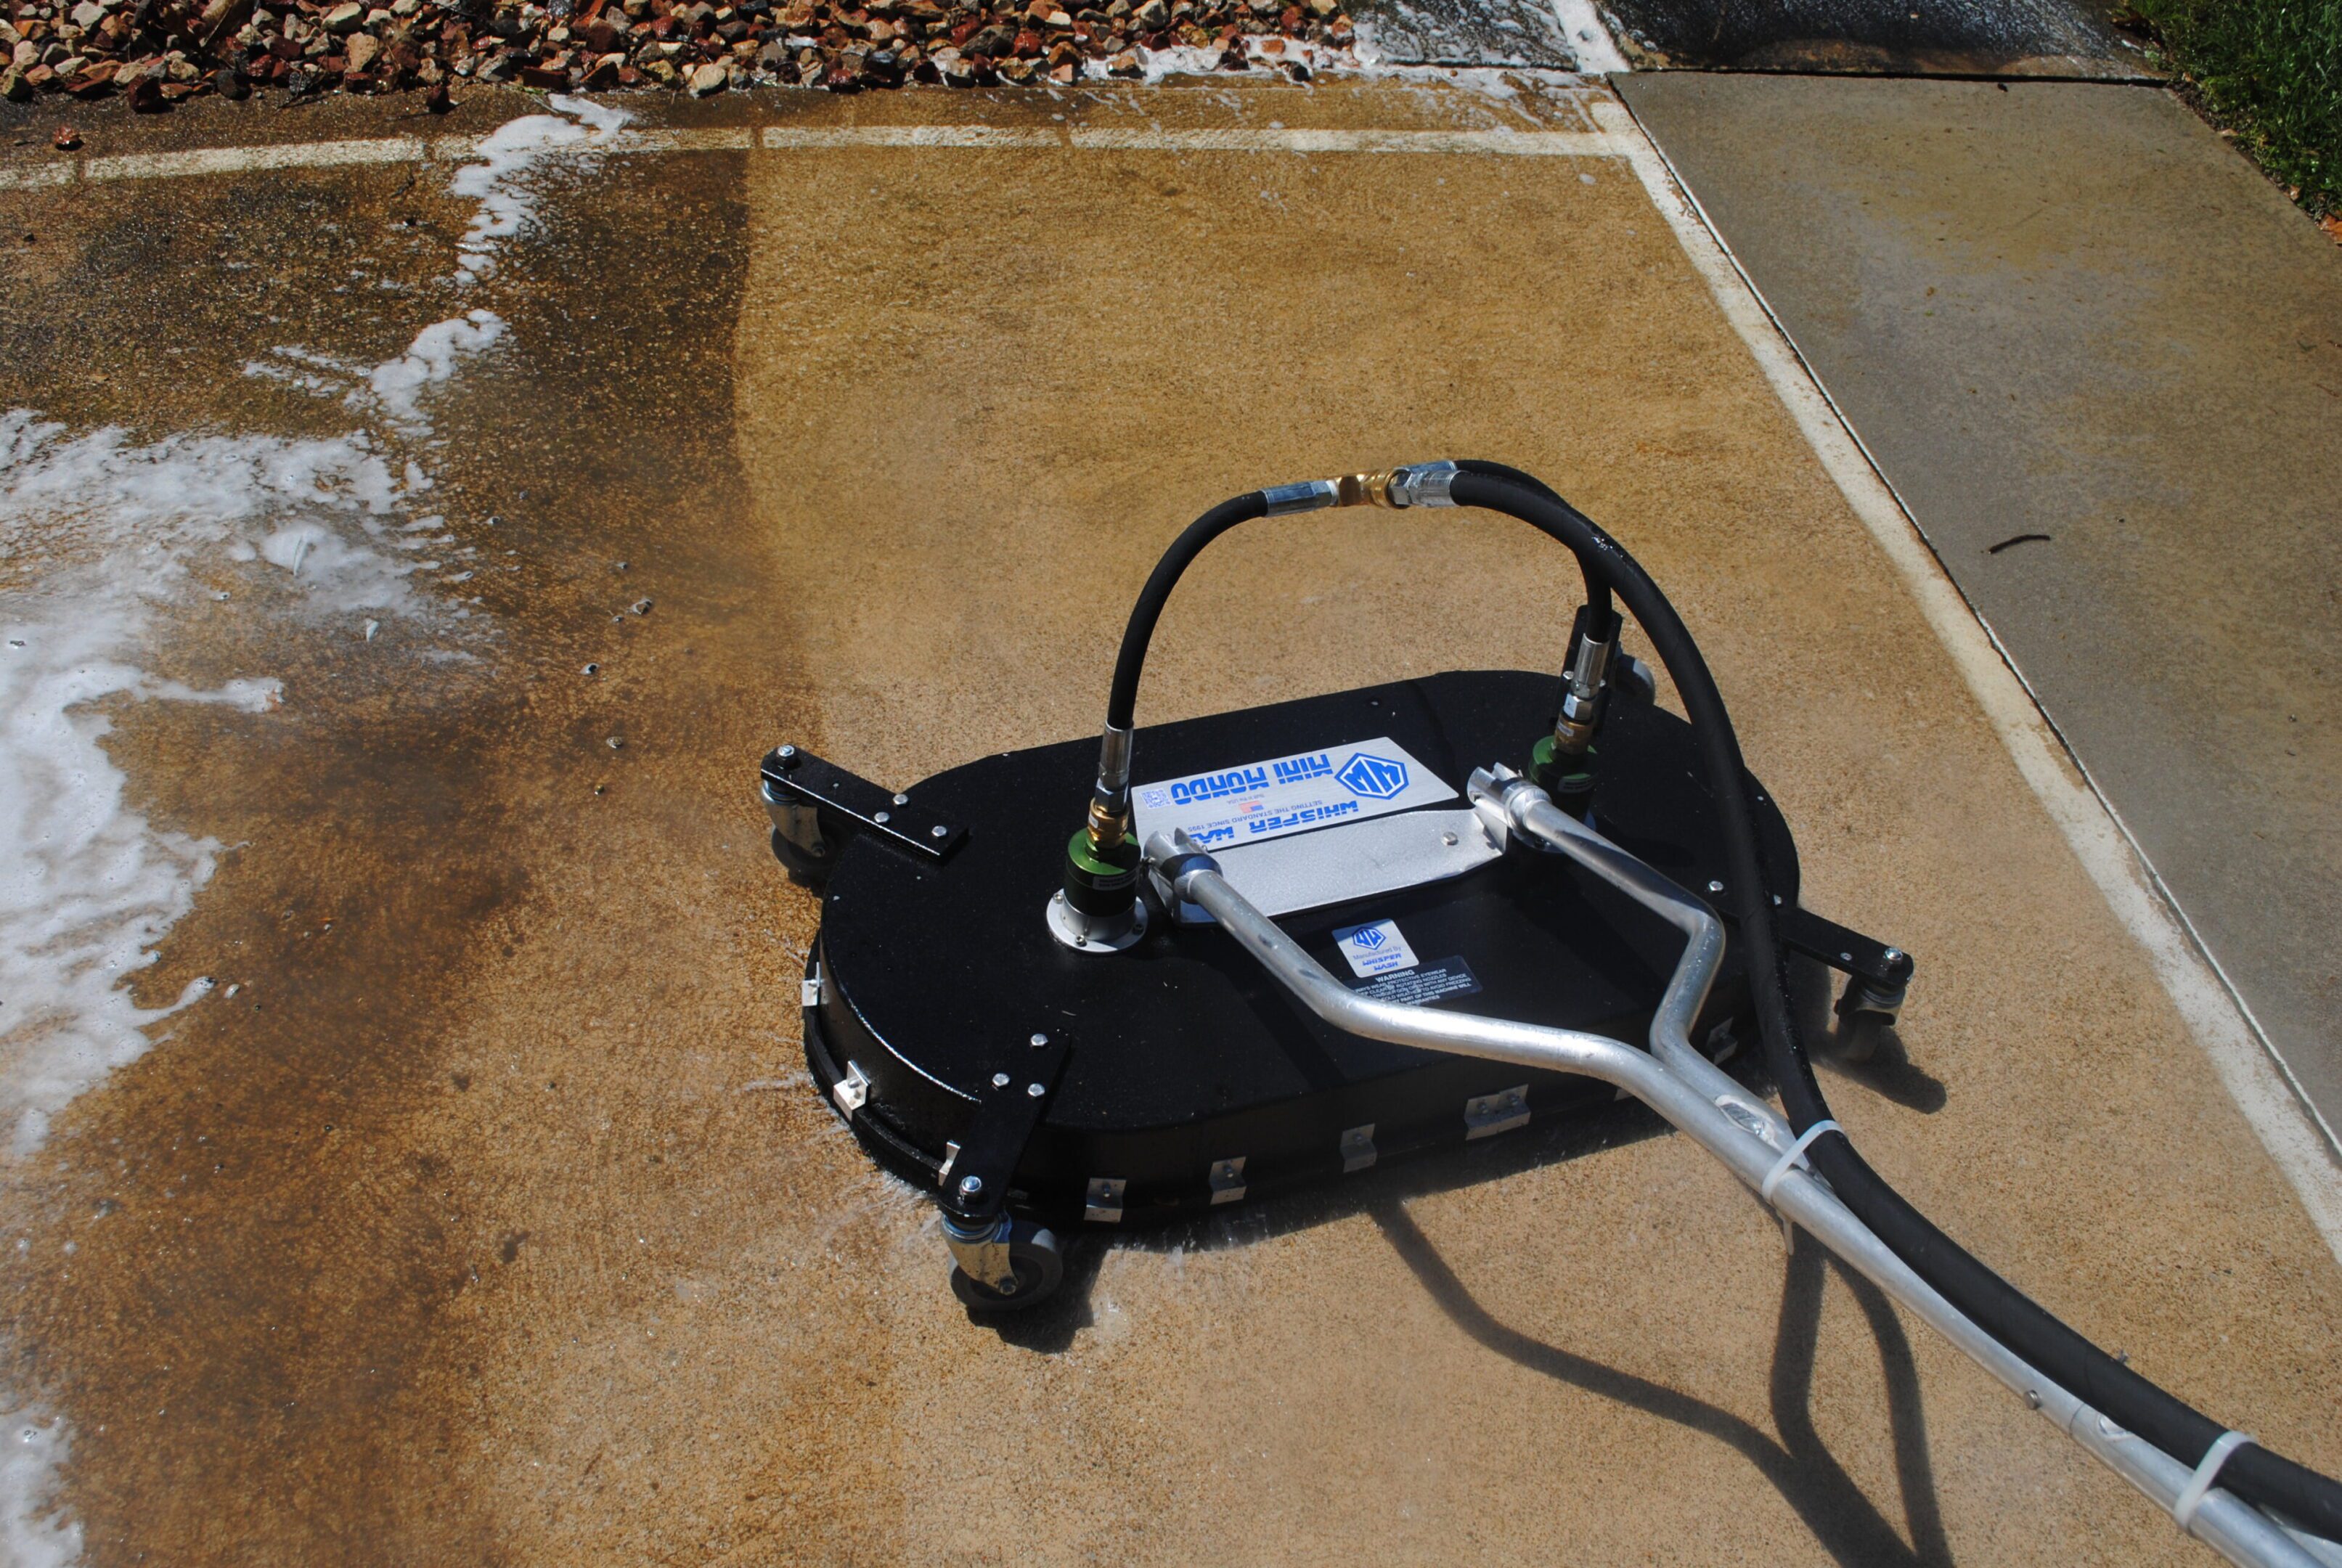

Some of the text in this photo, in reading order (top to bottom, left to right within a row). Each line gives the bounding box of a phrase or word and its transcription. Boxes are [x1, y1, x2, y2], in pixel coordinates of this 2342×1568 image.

[1170, 754, 1333, 805] MINI MONDO
[1276, 806, 1289, 814] THE
[1292, 800, 1323, 810] SETTING
[1188, 801, 1359, 844] WHISPER WA
[1232, 810, 1273, 823] STANDARD
[1353, 947, 1392, 960] Manufactured
[1362, 953, 1402, 965] WHISPER
[1374, 961, 1398, 971] WASH
[1375, 970, 1415, 983] WARNING
[1387, 974, 1421, 985] PROTECTIVE
[1421, 968, 1446, 977] EYEWEAR
